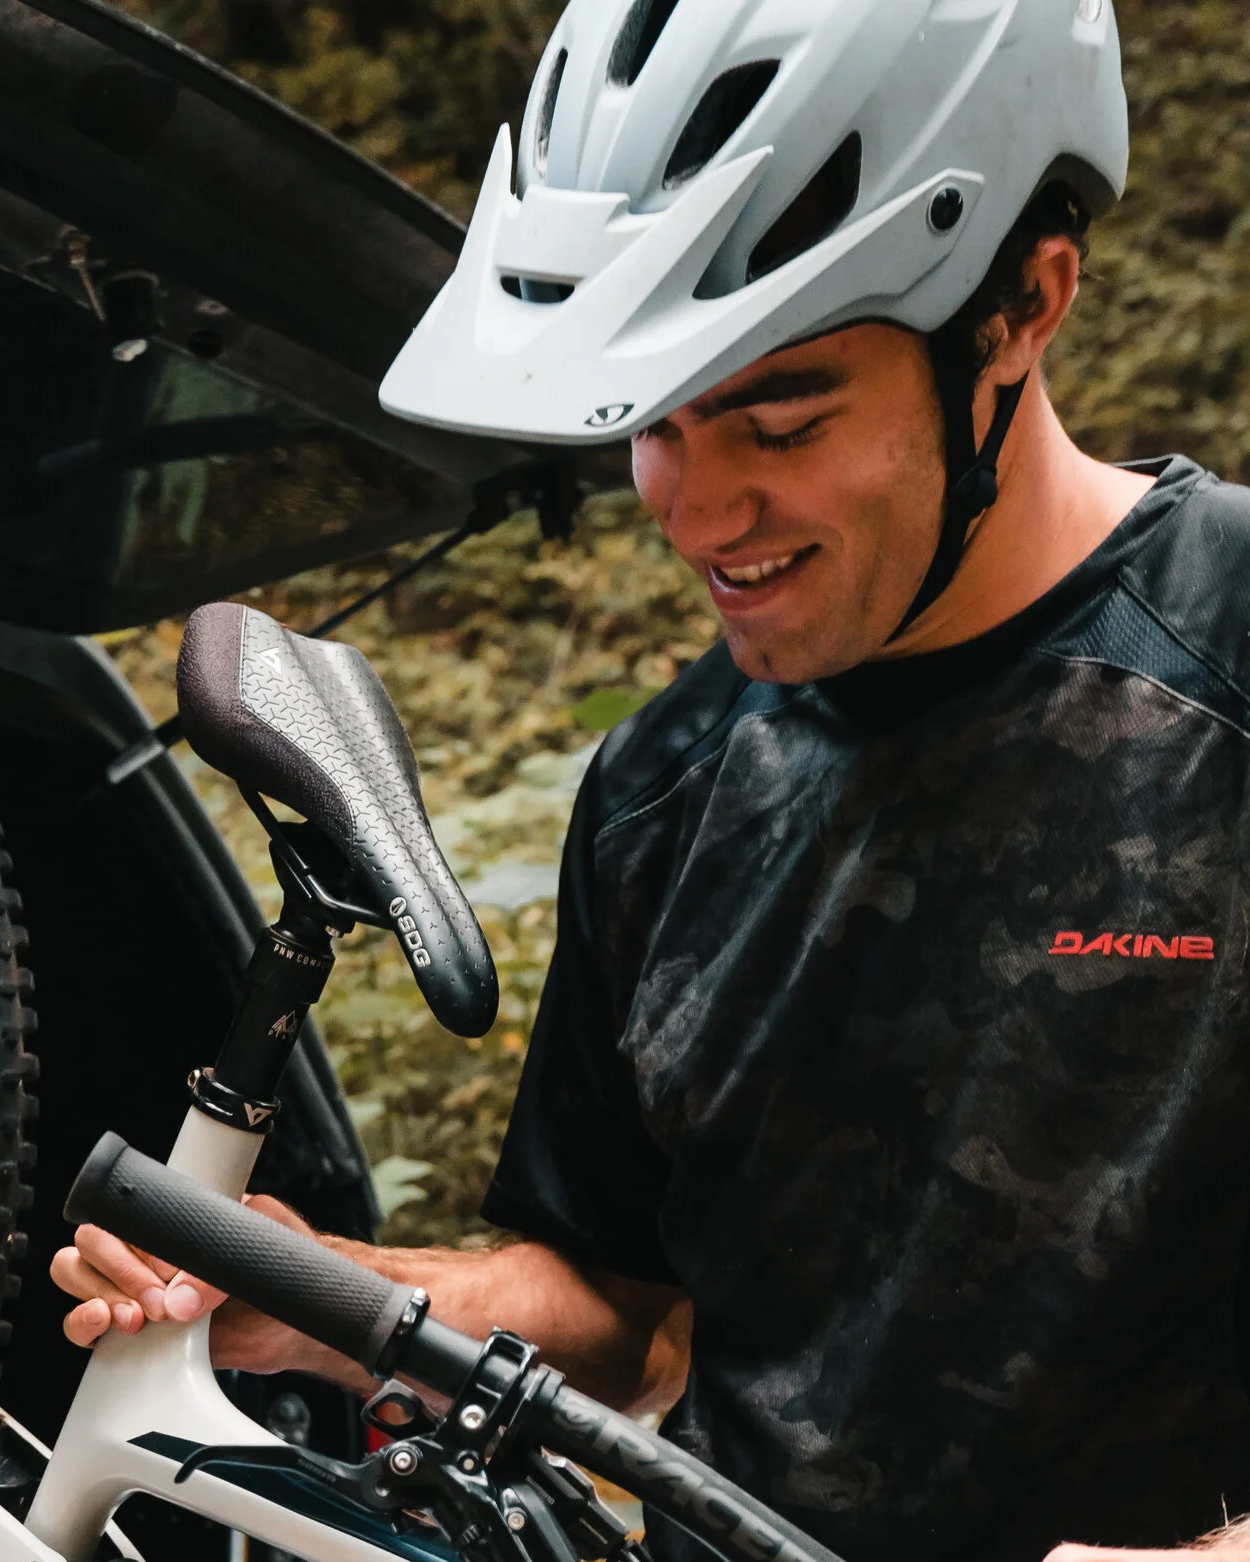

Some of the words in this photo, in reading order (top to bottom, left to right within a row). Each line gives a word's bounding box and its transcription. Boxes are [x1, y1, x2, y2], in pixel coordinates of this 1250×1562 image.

[273, 943, 294, 961] PNW
[397, 915, 431, 968] SDG
[1048, 931, 1214, 960] DAKINE
